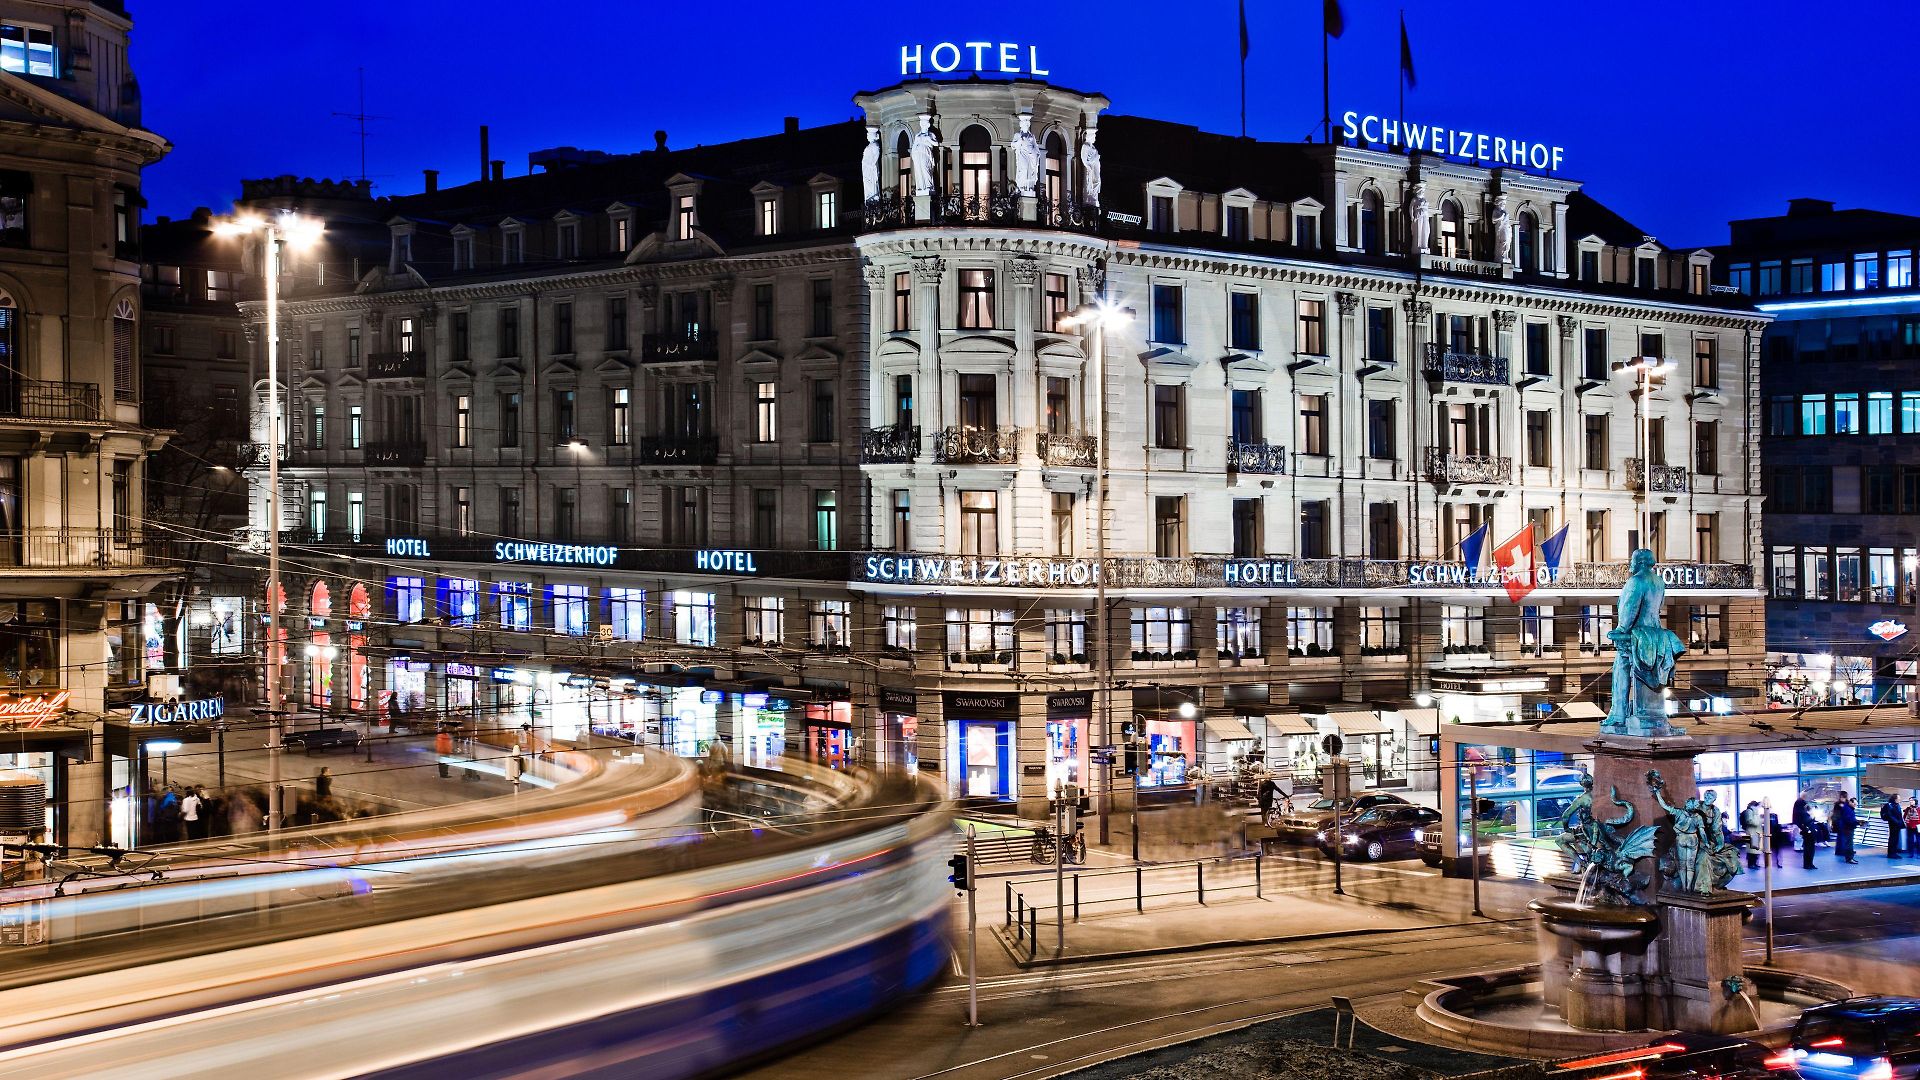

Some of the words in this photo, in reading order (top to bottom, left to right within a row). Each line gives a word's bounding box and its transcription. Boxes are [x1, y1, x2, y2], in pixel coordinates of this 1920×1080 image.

[901, 42, 1049, 76] HOTEL
[1343, 111, 1564, 171] SCHWEIZERHOF
[387, 538, 431, 557] HOTEL
[495, 542, 618, 565] SCHWEIZERHOF
[697, 551, 757, 572] HOTEL
[867, 557, 1100, 584] SCHWEIZERHOF
[1225, 563, 1297, 583] HOTEL
[1410, 565, 1561, 584] SCHWEIZEOF
[601, 628, 612, 637] 30
[1440, 681, 1463, 691] HOTEL
[0, 691, 71, 728] avidoff
[129, 699, 221, 724] ZIGARREN
[955, 697, 1005, 708] SWAROVSKI
[1052, 697, 1085, 708] SWAROVSKI
